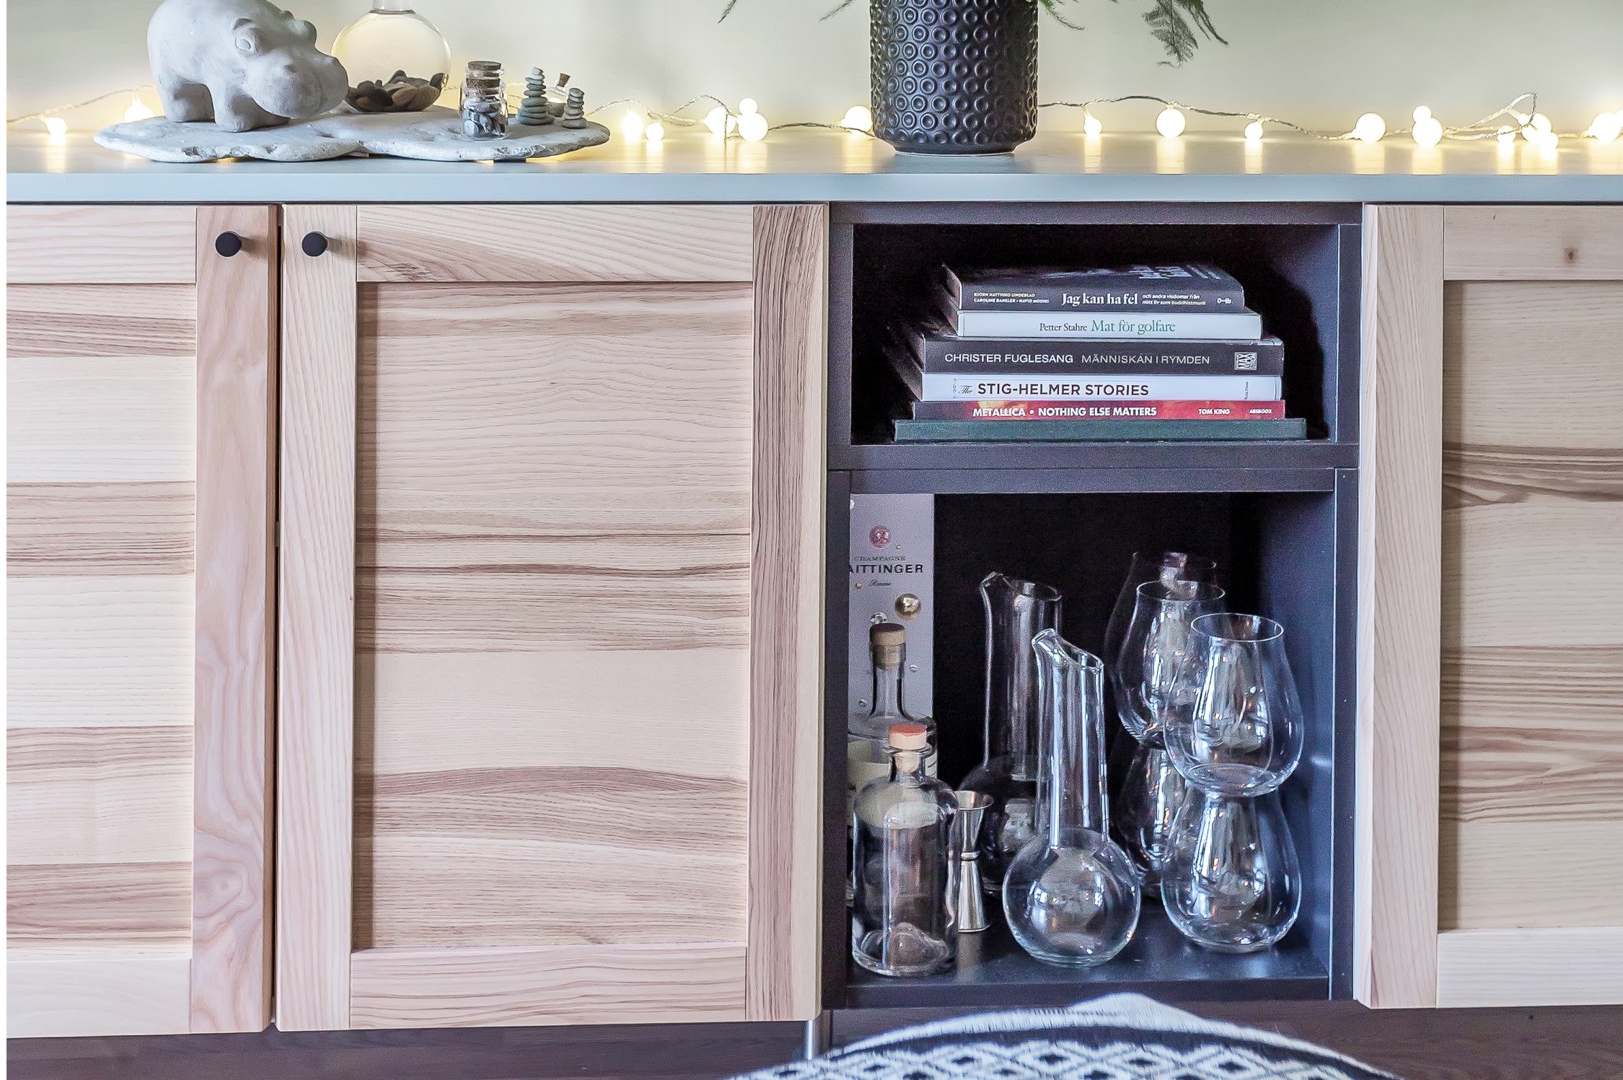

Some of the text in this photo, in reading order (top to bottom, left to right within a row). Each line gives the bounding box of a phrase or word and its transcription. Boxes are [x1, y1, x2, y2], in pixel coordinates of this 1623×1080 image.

[1060, 292, 1139, 307] Jag kan ha fel
[1039, 318, 1177, 336] Petter Stahre Mat för golfare
[944, 352, 1002, 364] CHRISTER
[1004, 353, 1074, 365] FUGLESANG
[1080, 352, 1153, 365] MÄNNISKAN
[1160, 354, 1211, 366] RYMDEN
[958, 382, 1150, 397] The STIG-HELMER STORIES
[972, 407, 1027, 418] METALLICA
[1037, 406, 1087, 418] NOTHING
[1088, 407, 1111, 418] ELSE
[1112, 406, 1158, 418] MATTERS
[848, 563, 924, 574] AITTINGER
